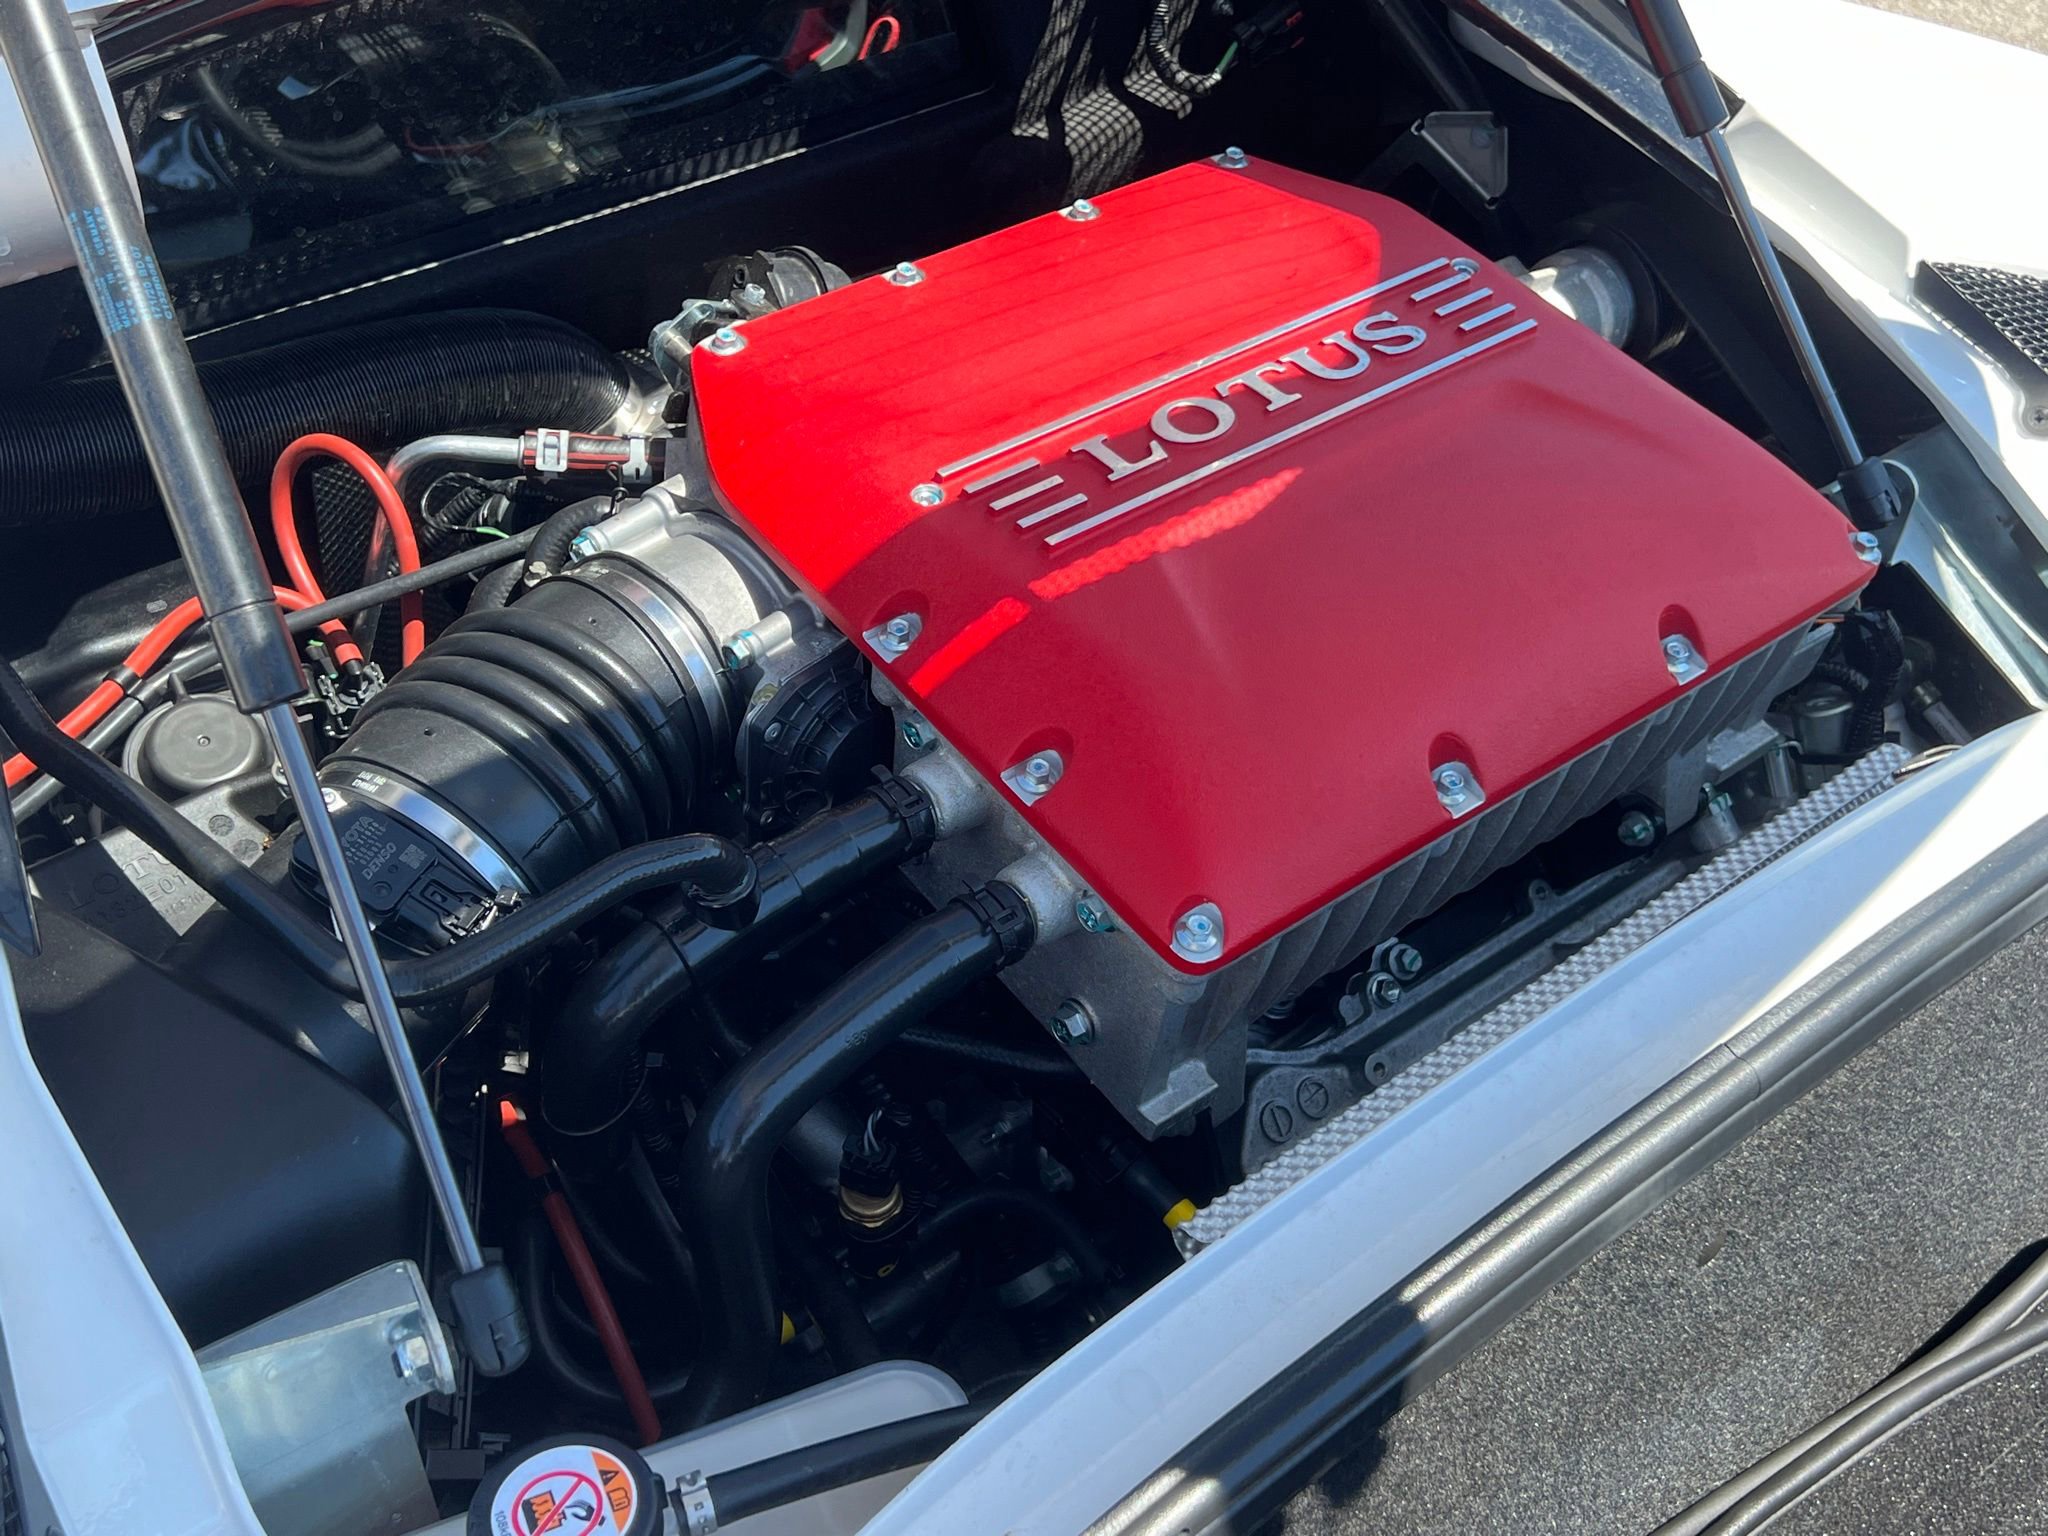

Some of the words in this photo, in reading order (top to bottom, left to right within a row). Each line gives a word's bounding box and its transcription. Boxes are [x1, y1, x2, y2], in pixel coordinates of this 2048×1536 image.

[83, 210, 105, 256] GERMANY
[105, 272, 116, 284] IN
[115, 301, 131, 328] MADE
[1070, 311, 1427, 482] LOTUS
[361, 842, 397, 880] DENSO
